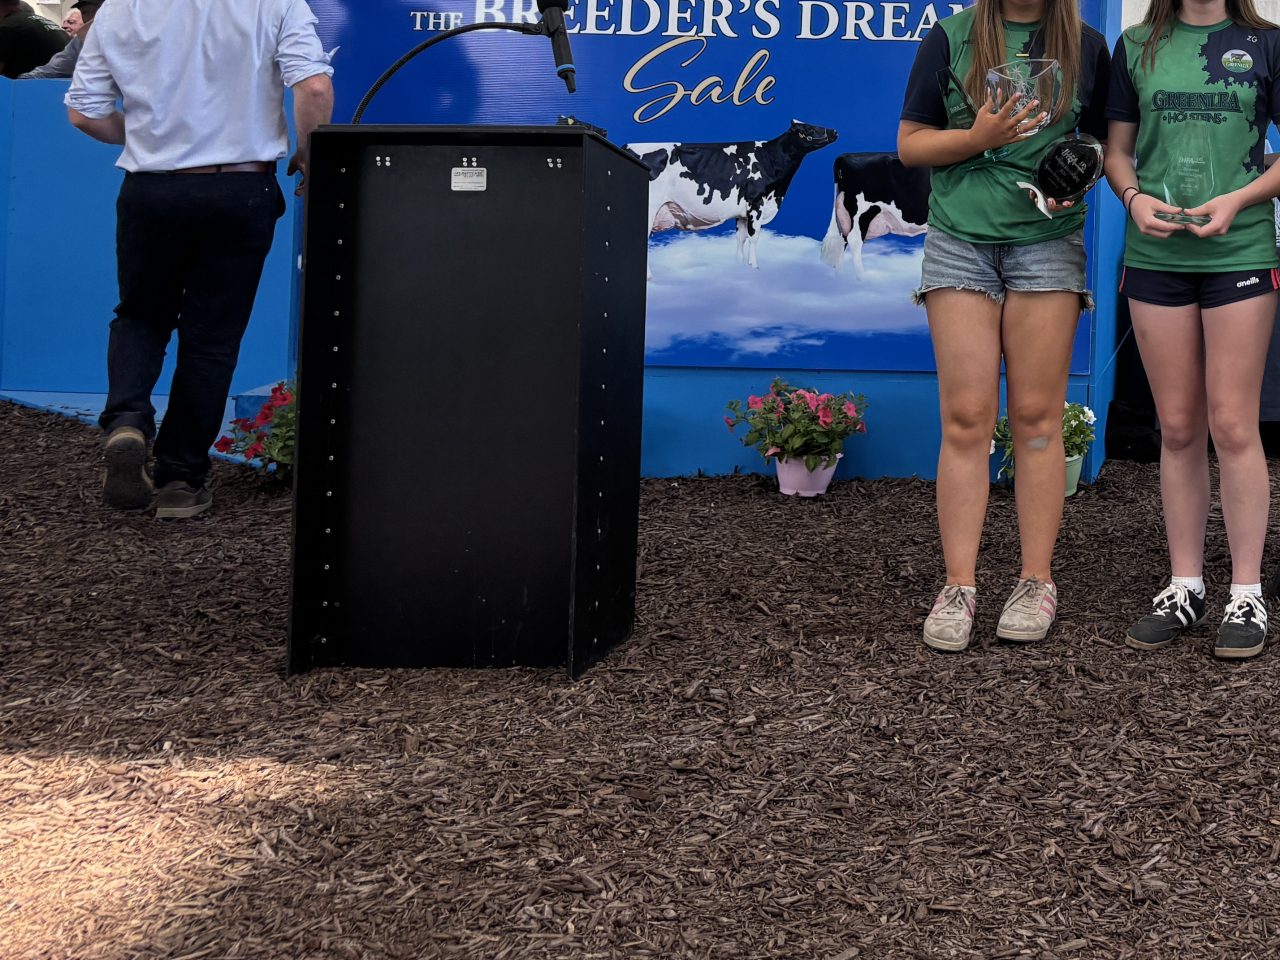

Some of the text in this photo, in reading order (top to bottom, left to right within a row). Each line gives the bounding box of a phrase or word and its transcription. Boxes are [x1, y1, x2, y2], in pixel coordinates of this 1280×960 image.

[410, 11, 463, 31] THE
[795, 0, 965, 41] DREA
[1246, 35, 1258, 43] ZG
[622, 35, 777, 124] Sale
[1151, 89, 1241, 111] GREENLEA
